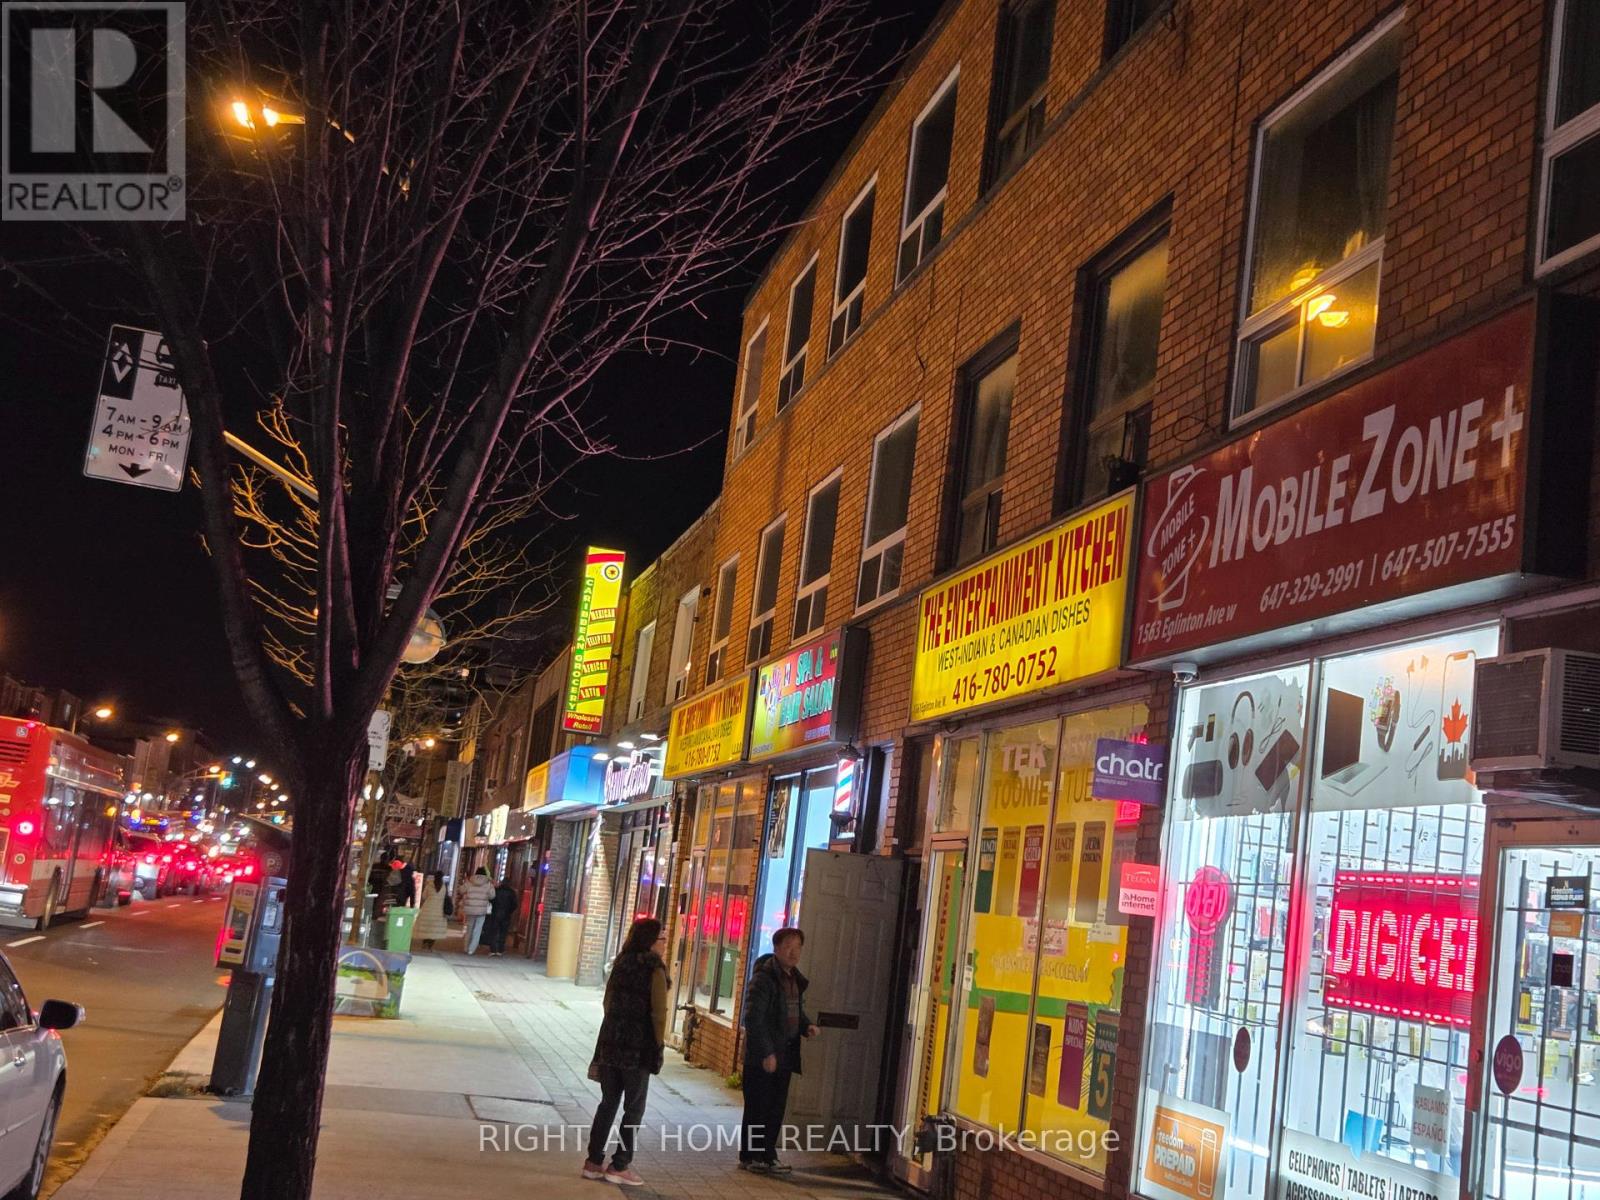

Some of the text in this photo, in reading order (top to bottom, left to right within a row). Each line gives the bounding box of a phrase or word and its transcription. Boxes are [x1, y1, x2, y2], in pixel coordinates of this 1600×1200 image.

[109, 443, 135, 457] MON
[1160, 493, 1195, 549] MOBILE
[923, 504, 1129, 653] THE ENTERTAINMENT KITCHEN
[1259, 560, 1363, 613] 647-329-2991
[1381, 514, 1517, 581] 647-507-7555
[937, 637, 987, 673] WEST-INDIAN
[999, 615, 1049, 650] CANADIAN
[1050, 598, 1091, 634] DISHES
[1137, 618, 1160, 645] 1563
[1161, 609, 1204, 643] Eglinton
[1203, 604, 1226, 628] Ave
[568, 655, 584, 711] GROCERY
[796, 649, 813, 686] SPA
[952, 646, 1058, 704] 416-780-0752
[801, 677, 836, 720] SALON
[1096, 752, 1163, 782] chatr
[1121, 901, 1155, 911] internet
[1130, 893, 1156, 903] Home
[1154, 1144, 1196, 1178] PREPAID
[1288, 1149, 1341, 1187] CELLPHONES
[1347, 1168, 1387, 1200] TABLETS
